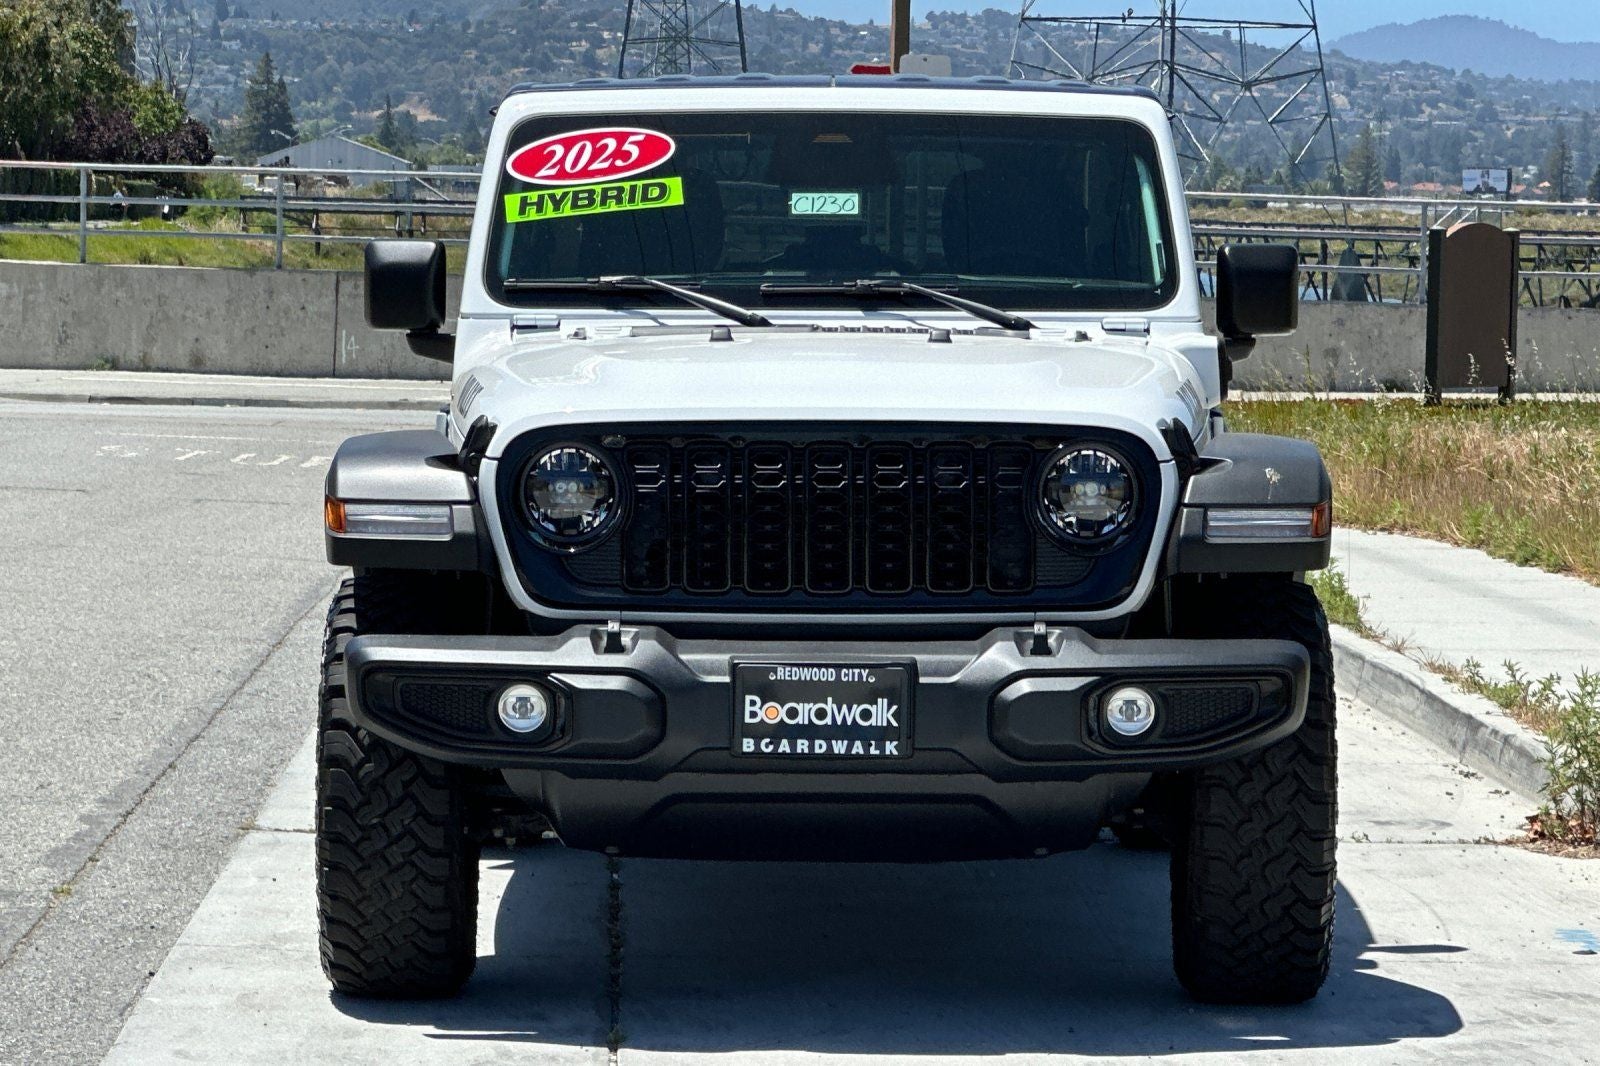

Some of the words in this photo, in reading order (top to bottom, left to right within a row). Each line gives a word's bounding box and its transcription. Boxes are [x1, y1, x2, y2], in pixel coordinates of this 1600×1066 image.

[534, 134, 646, 177] 2025
[517, 182, 671, 217] HYBRID
[793, 195, 856, 214] C1230
[342, 329, 360, 364] 14
[776, 667, 835, 681] REDWOOD
[840, 669, 869, 682] CITY
[744, 694, 899, 727] Boardwalk
[742, 737, 899, 755] BOARDWALK
